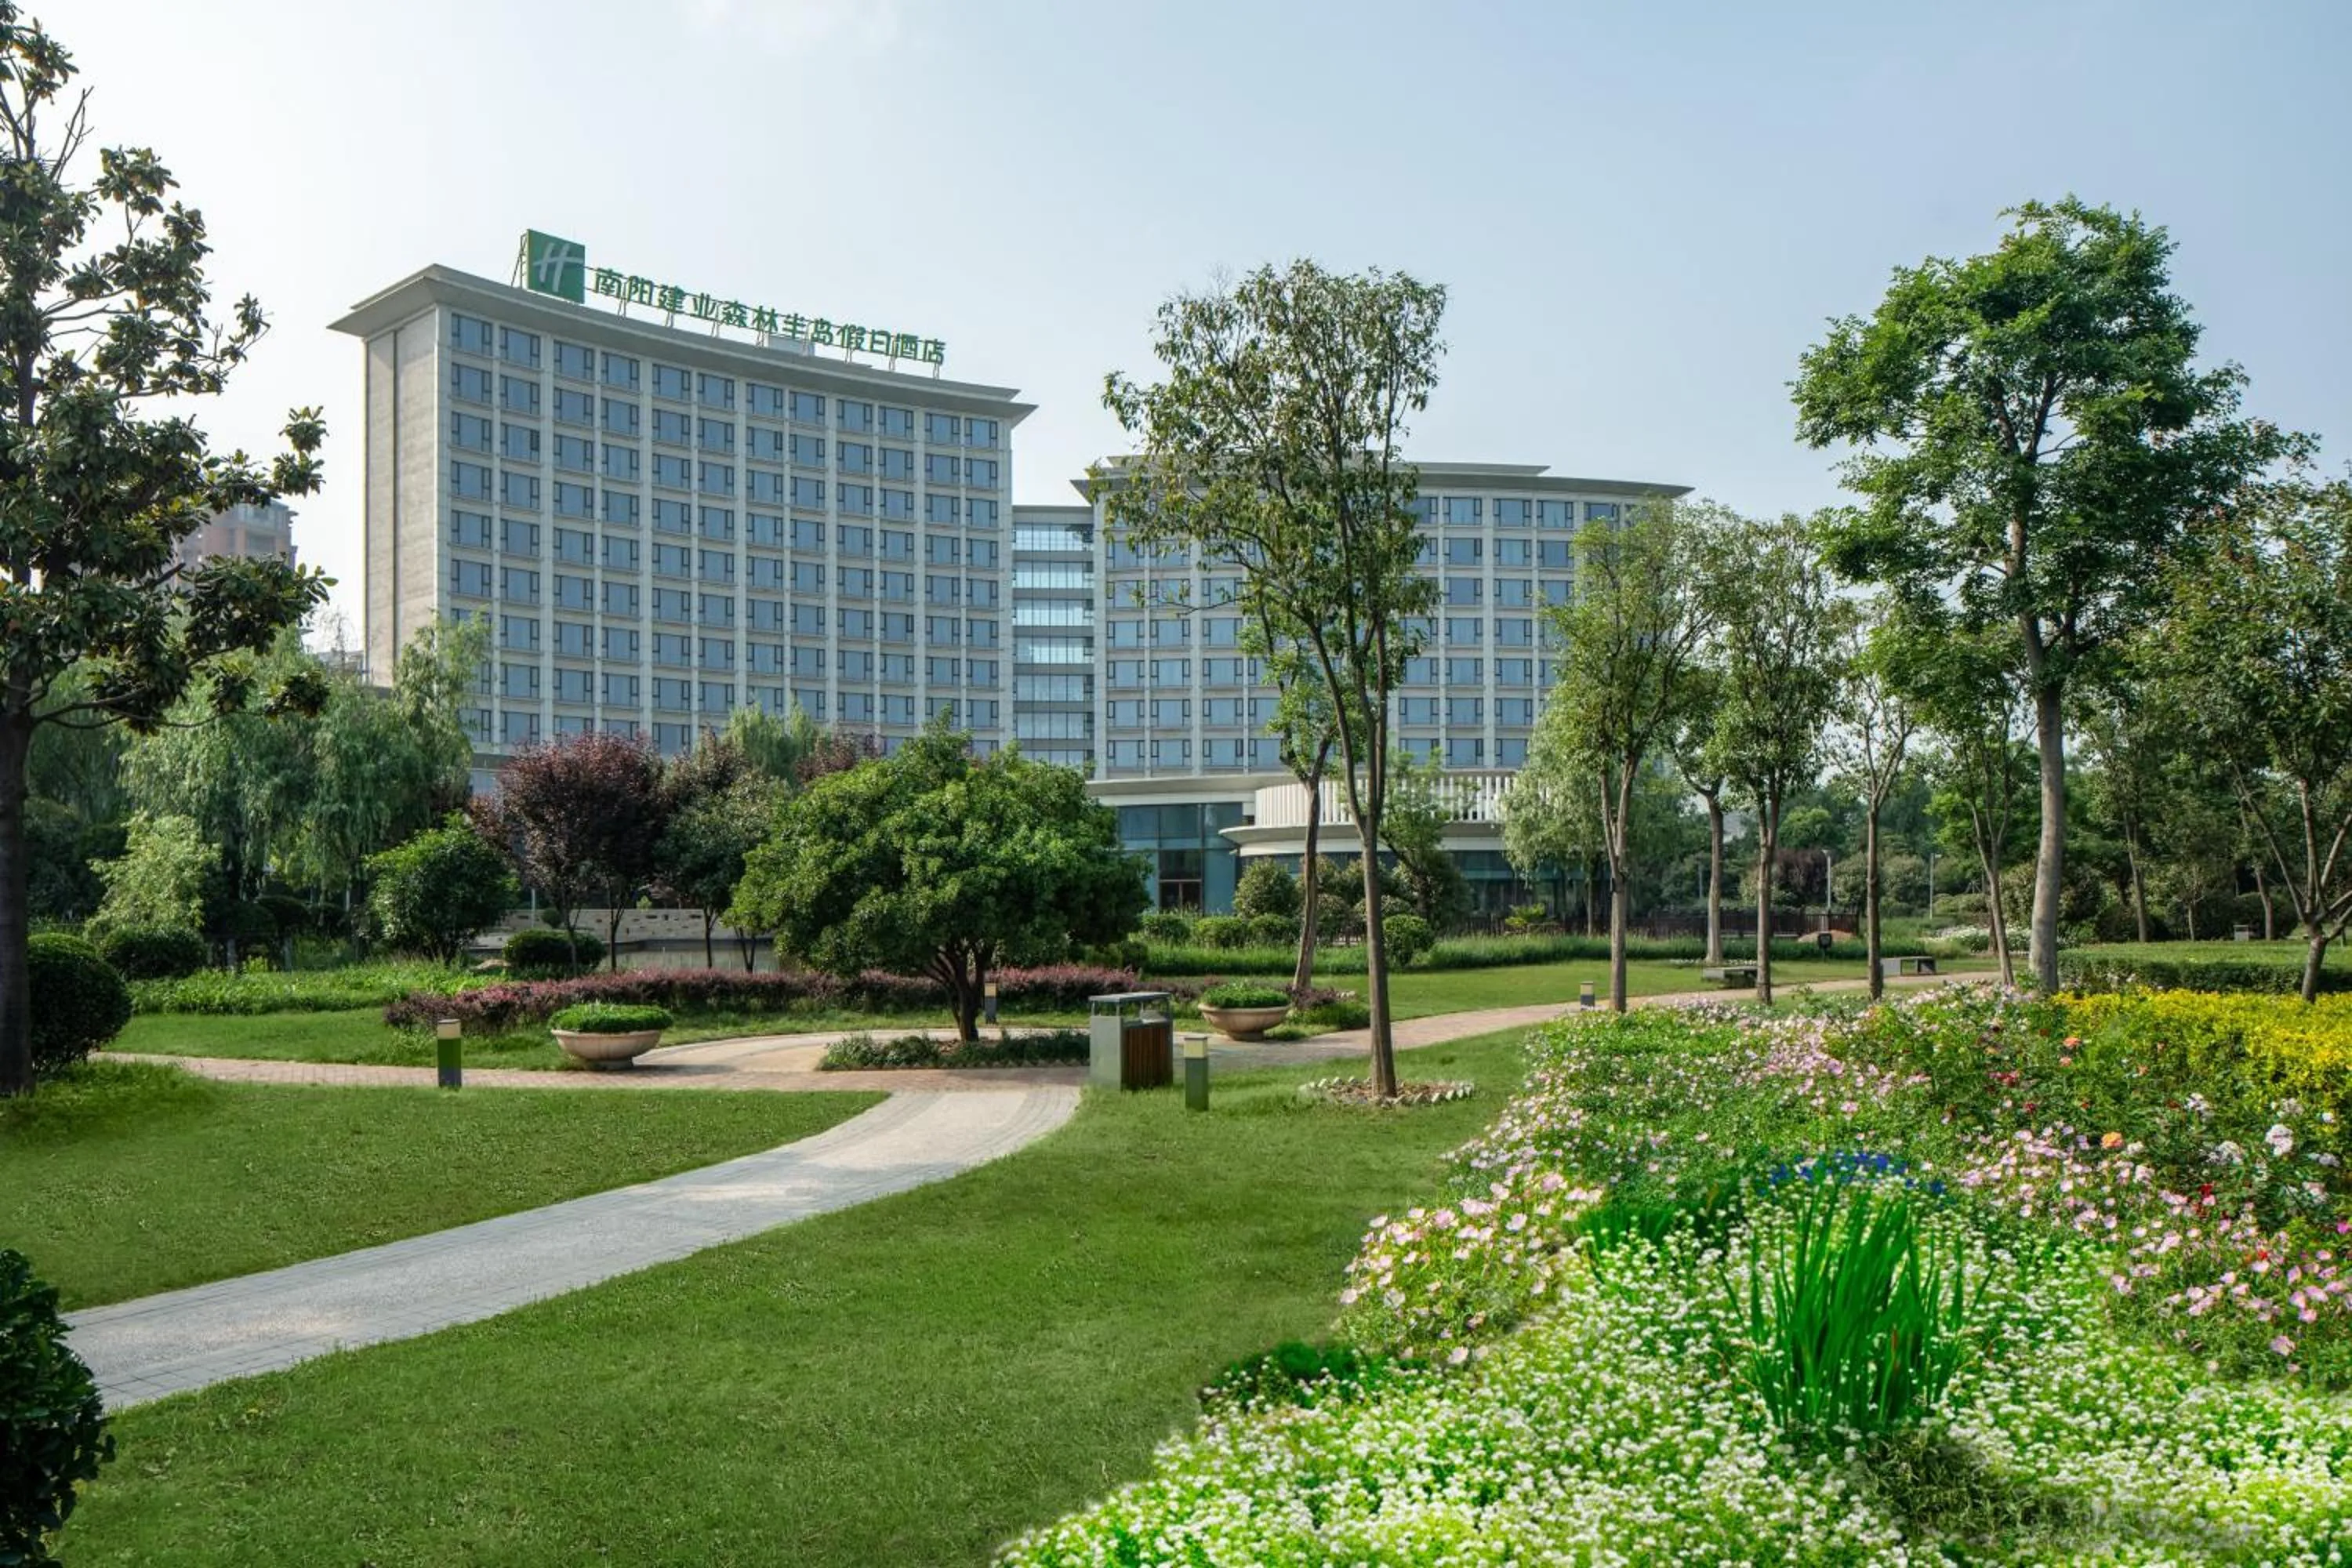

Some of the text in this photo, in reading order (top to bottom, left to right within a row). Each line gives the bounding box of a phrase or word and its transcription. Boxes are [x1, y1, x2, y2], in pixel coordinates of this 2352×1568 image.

[595, 268, 946, 365] 南阳建业森林半岛假日酒店
